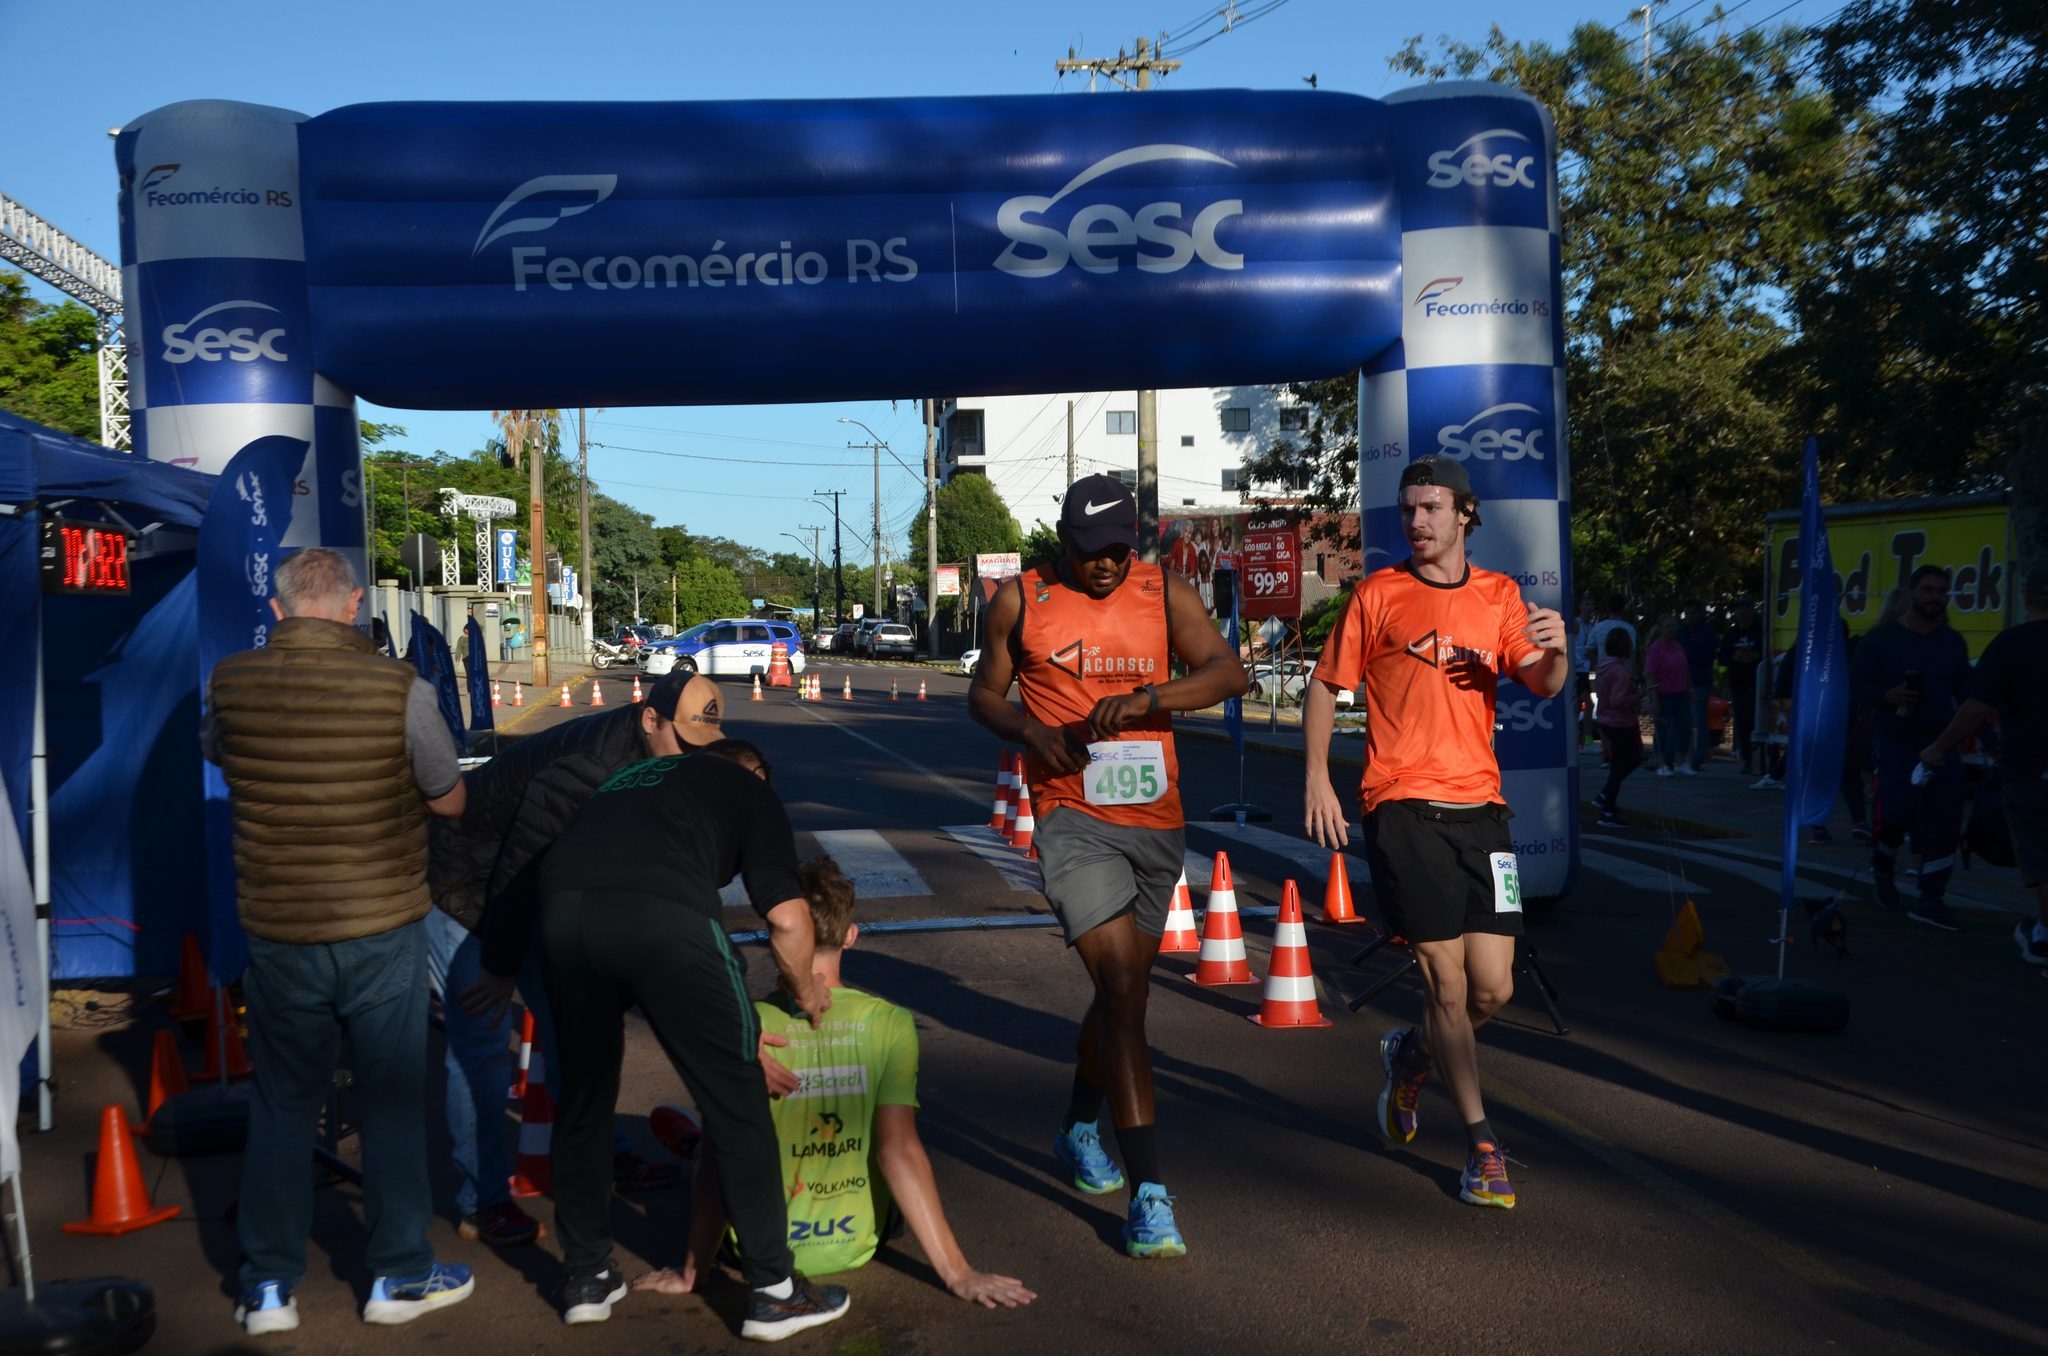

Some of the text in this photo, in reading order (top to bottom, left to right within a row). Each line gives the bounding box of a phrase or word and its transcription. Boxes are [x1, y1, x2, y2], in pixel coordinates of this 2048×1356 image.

[1426, 150, 1535, 189] Sesc
[148, 187, 293, 208] Fecomércio RS
[992, 195, 1244, 278] Sesc
[511, 237, 918, 292] Fecomércio RS
[1426, 299, 1549, 317] Fecomércio RS
[162, 324, 288, 364] Sesc
[1384, 442, 1402, 458] RS
[1438, 425, 1544, 461] Sesc
[1256, 543, 1272, 551] MEGA
[1276, 541, 1285, 550] 60
[1276, 551, 1290, 559] GIGA
[502, 547, 512, 580] URI
[1777, 529, 2003, 618] Fd Tck
[253, 553, 268, 597] Sesc
[1542, 571, 1558, 586] RS
[1083, 657, 1154, 672] ACORSEB
[1091, 752, 1119, 761] Sesc
[1096, 765, 1158, 799] 495
[785, 1022, 865, 1033] ATLTISMO
[812, 1071, 862, 1090] Sicredi
[792, 1138, 862, 1158] LAMBARI
[807, 1177, 866, 1195] VOLKANO
[790, 1215, 856, 1240] ZUK
